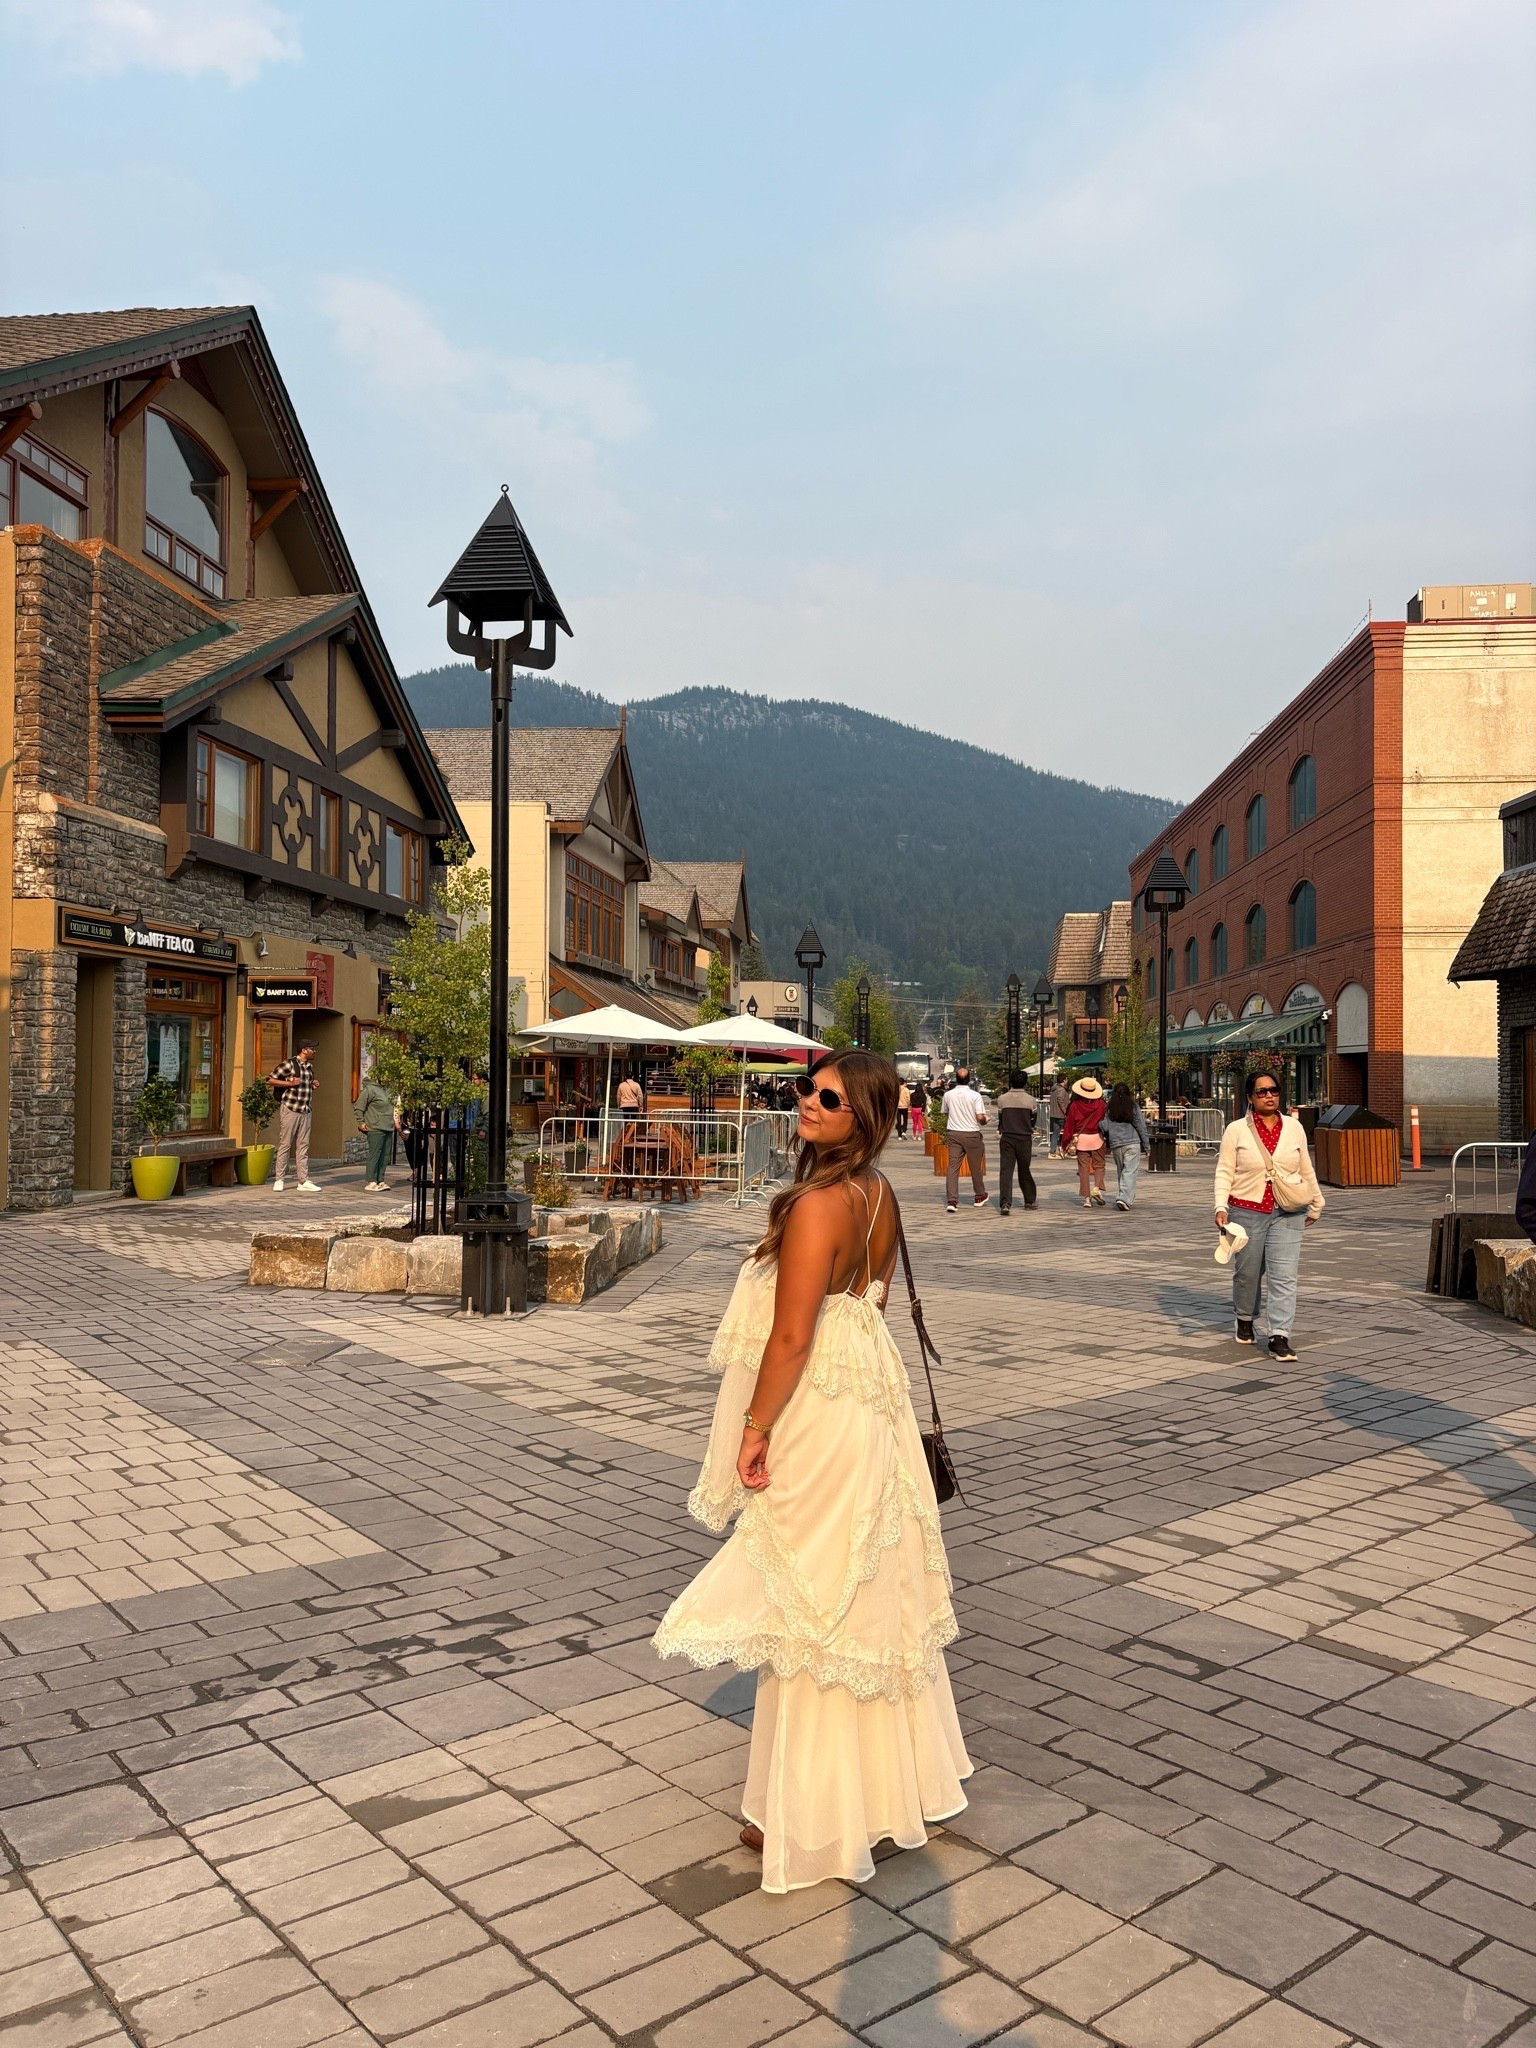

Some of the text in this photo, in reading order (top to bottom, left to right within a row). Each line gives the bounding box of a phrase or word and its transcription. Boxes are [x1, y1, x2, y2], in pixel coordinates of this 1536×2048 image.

[70, 922, 113, 937] EXCLUSIVE TEA BLENDS
[136, 931, 196, 954] BANFF TEA CO.
[297, 989, 309, 997] CO.
